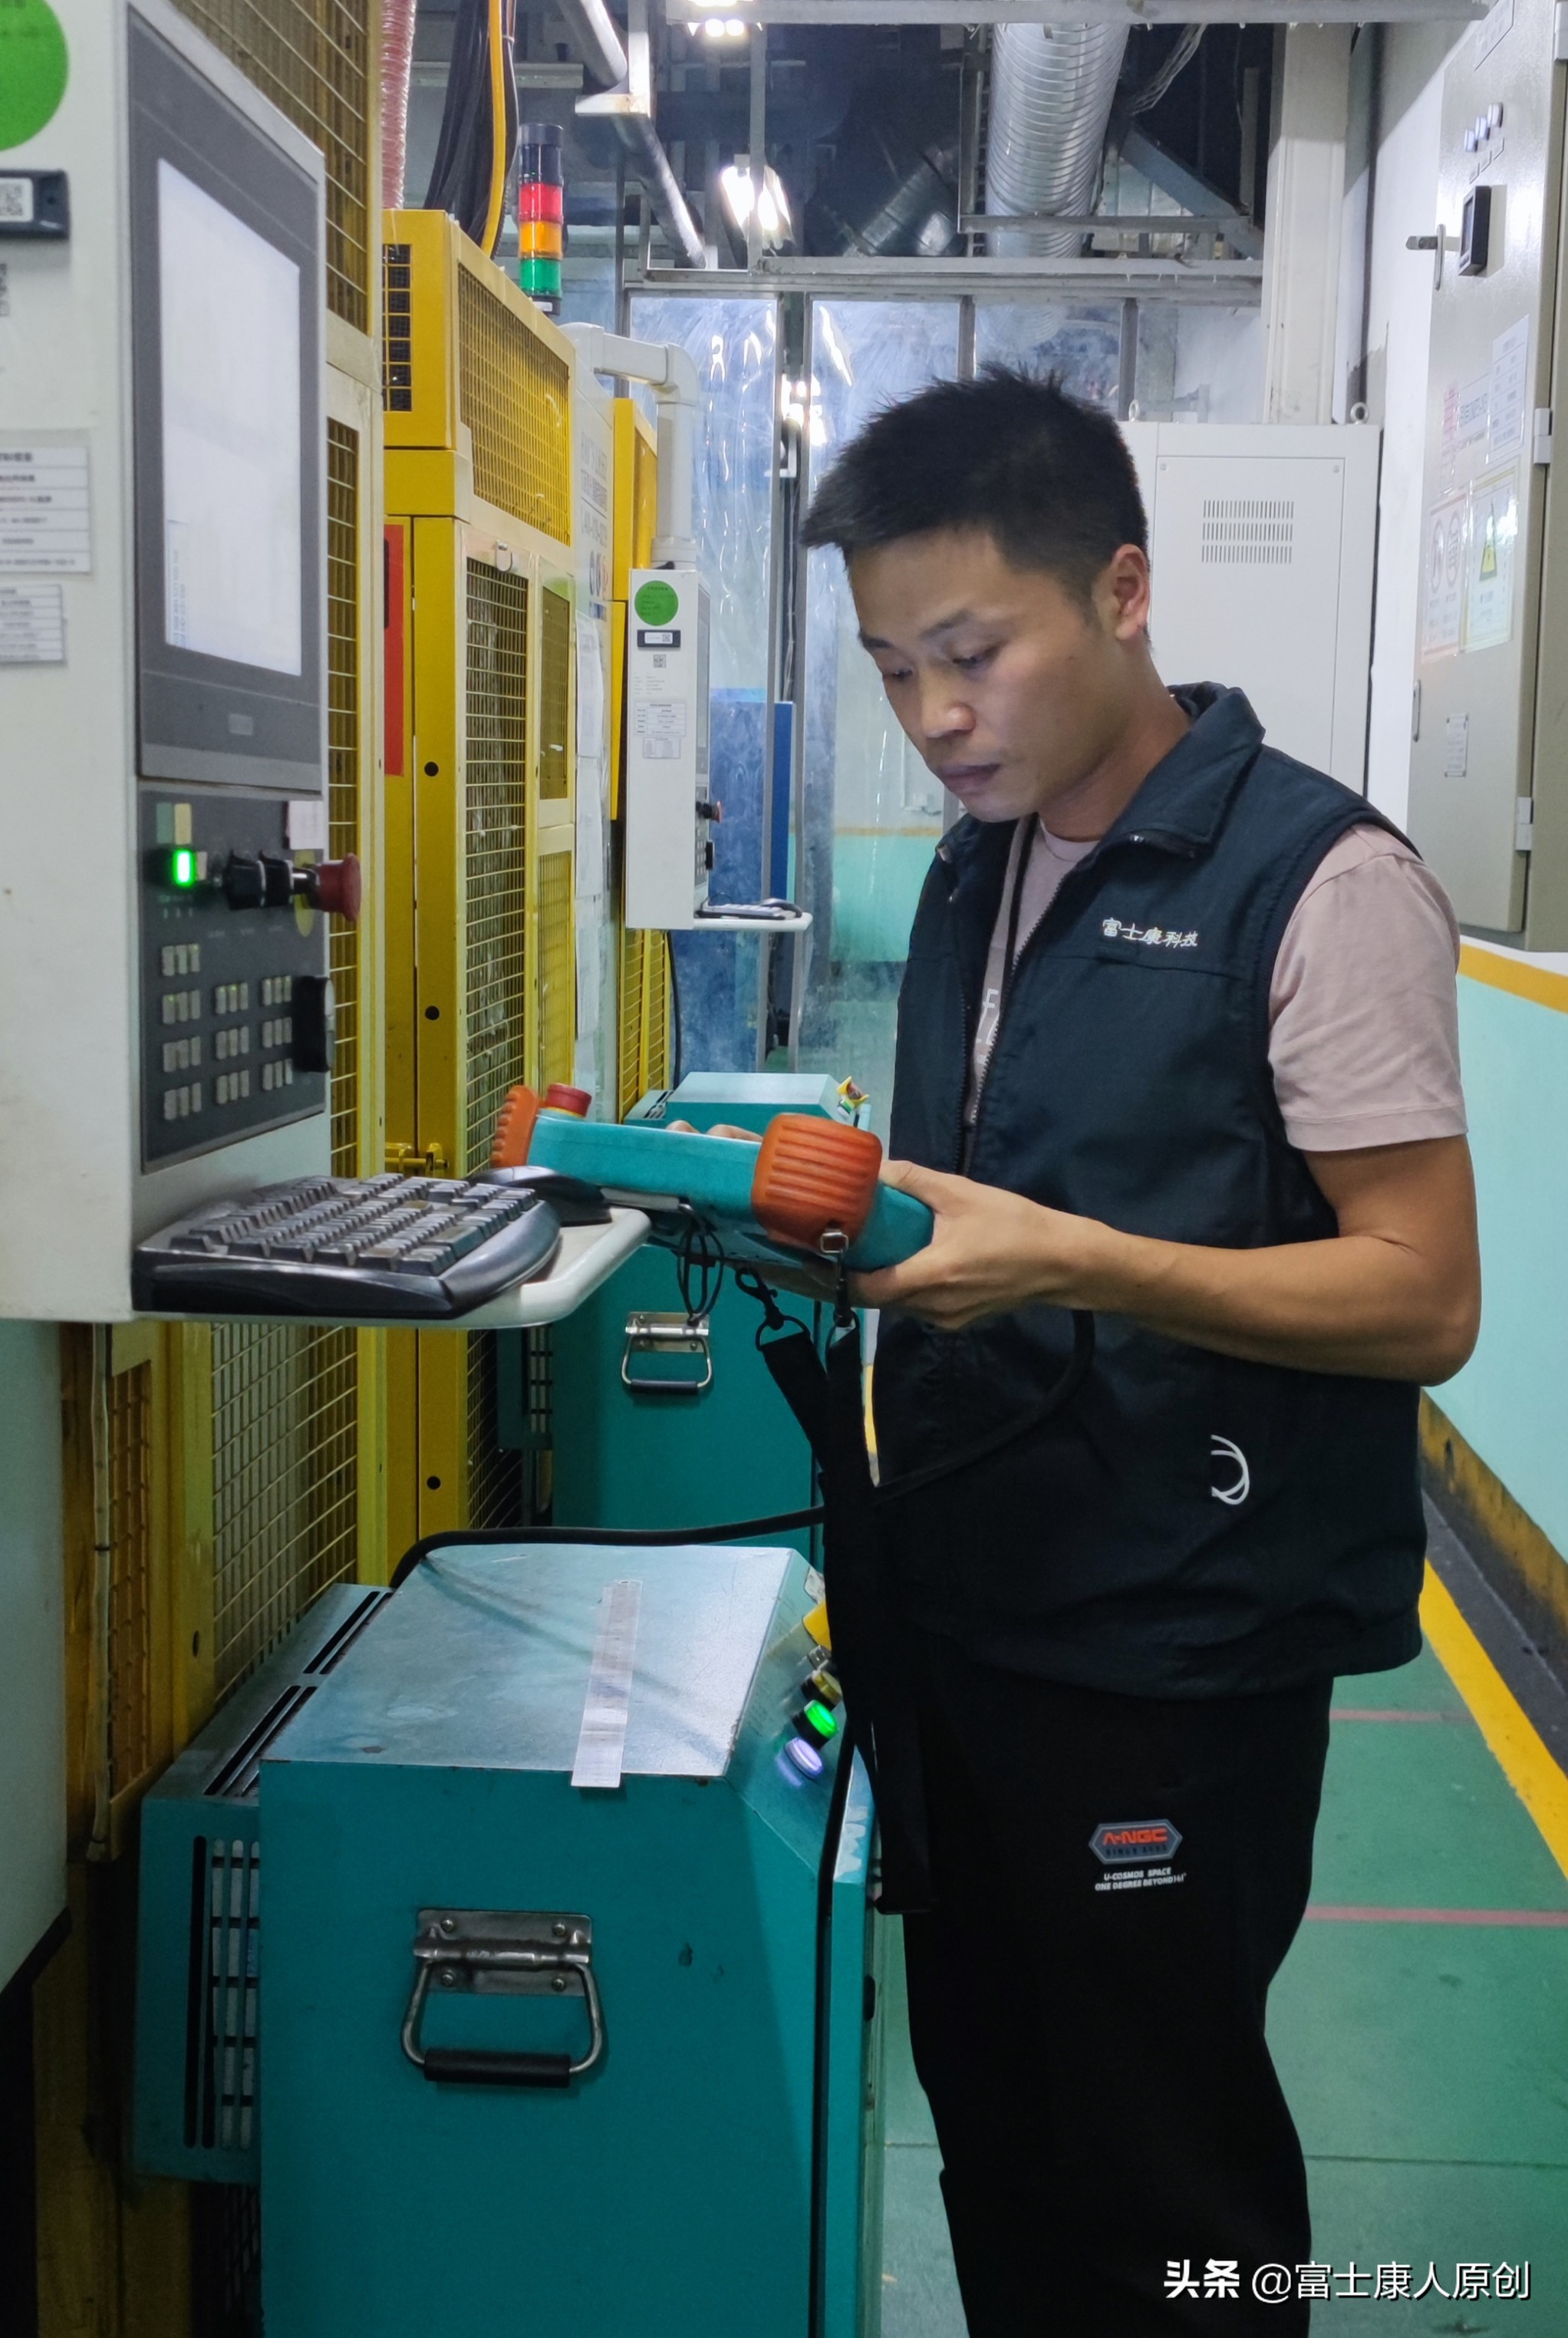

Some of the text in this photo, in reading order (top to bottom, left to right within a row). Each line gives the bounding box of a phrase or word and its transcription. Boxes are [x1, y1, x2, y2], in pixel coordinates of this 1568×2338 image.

[1102, 917, 1198, 948] 富士康科技
